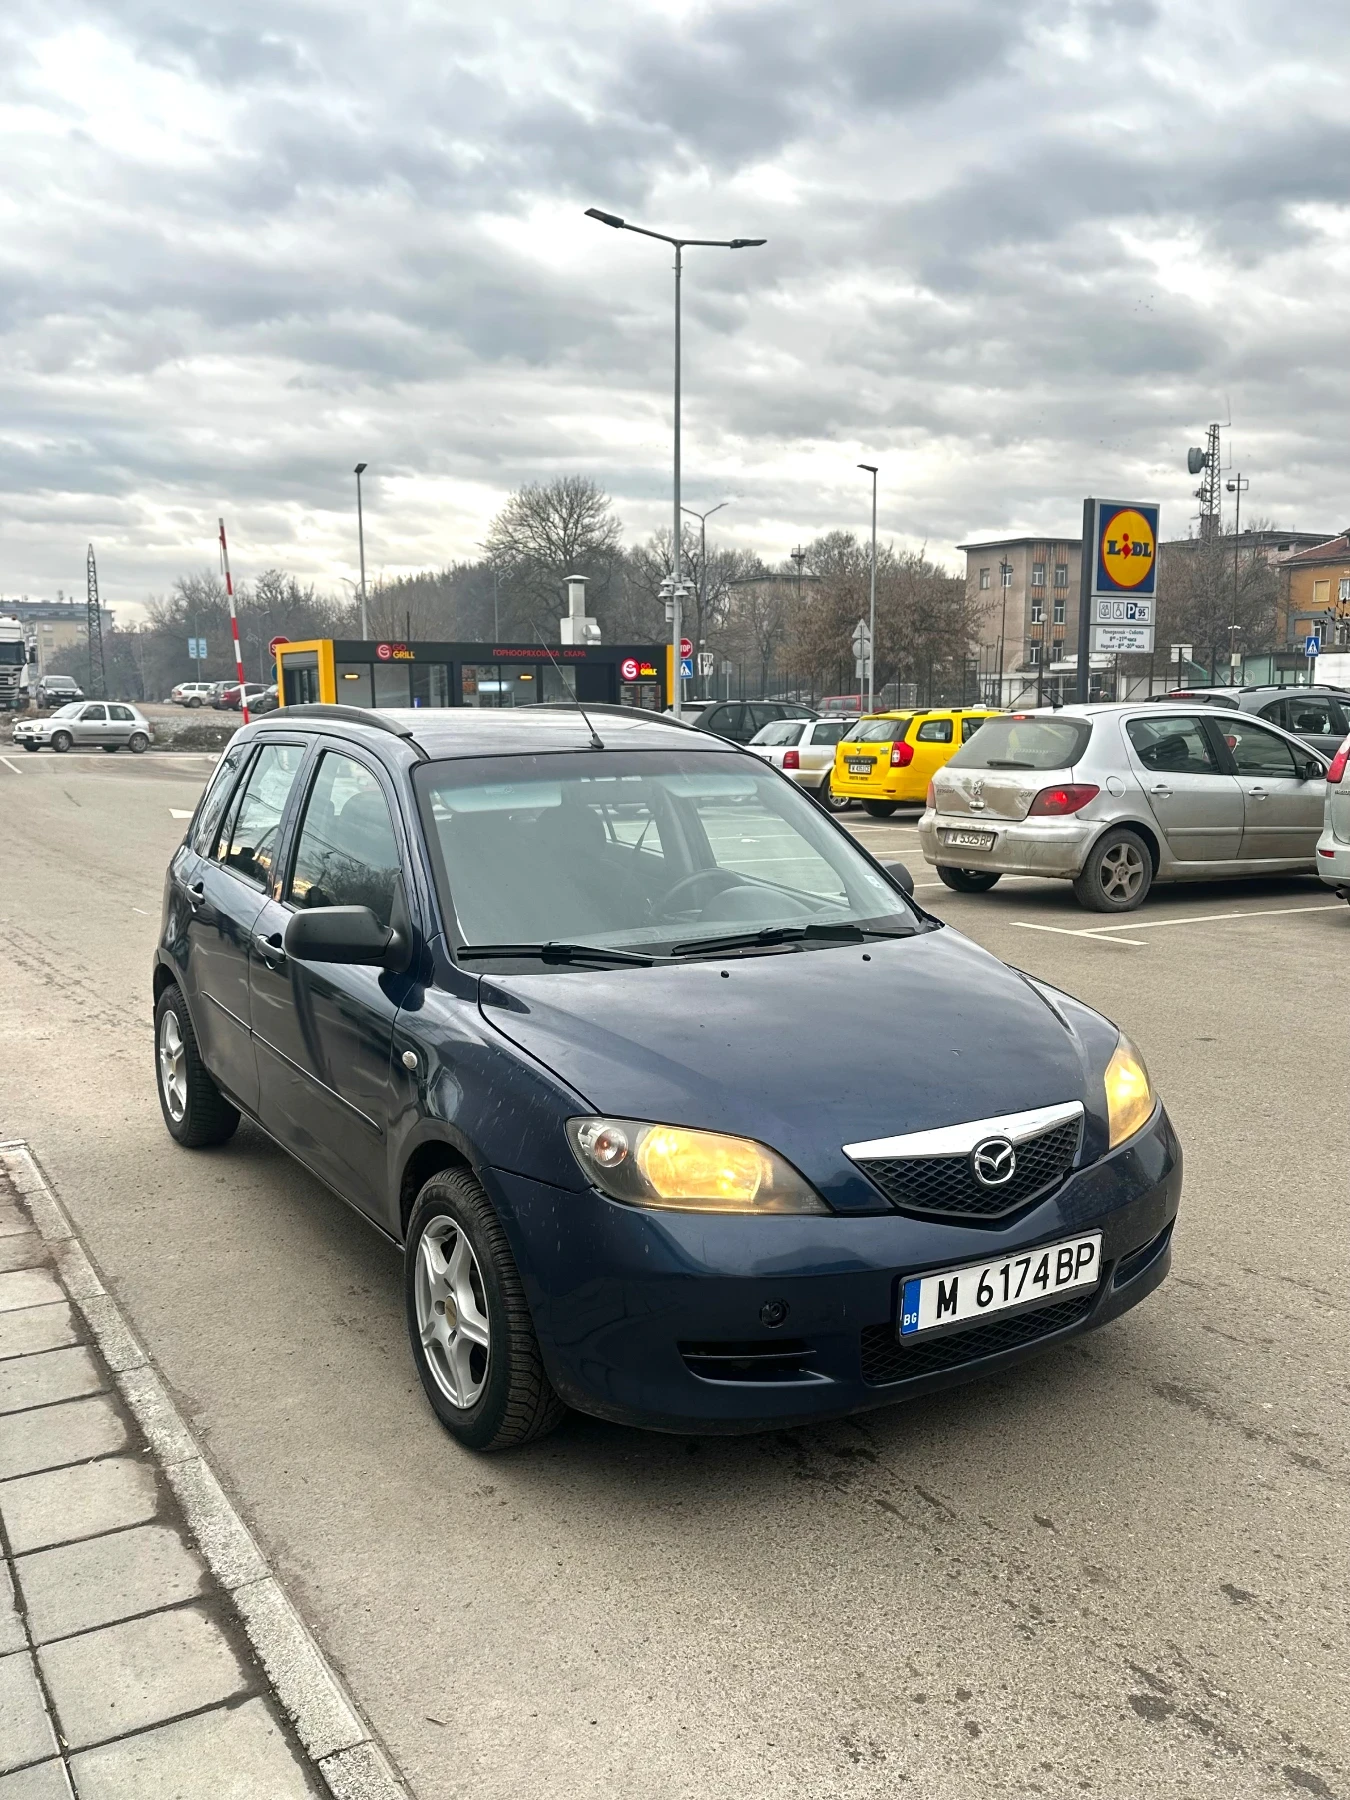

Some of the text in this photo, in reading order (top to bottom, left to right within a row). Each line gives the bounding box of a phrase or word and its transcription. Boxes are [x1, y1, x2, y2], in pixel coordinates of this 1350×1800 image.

[1138, 608, 1146, 617] 95
[680, 644, 691, 652] TOP
[392, 650, 415, 659] GRILL
[936, 1276, 959, 1320] M
[903, 1312, 917, 1326] BG
